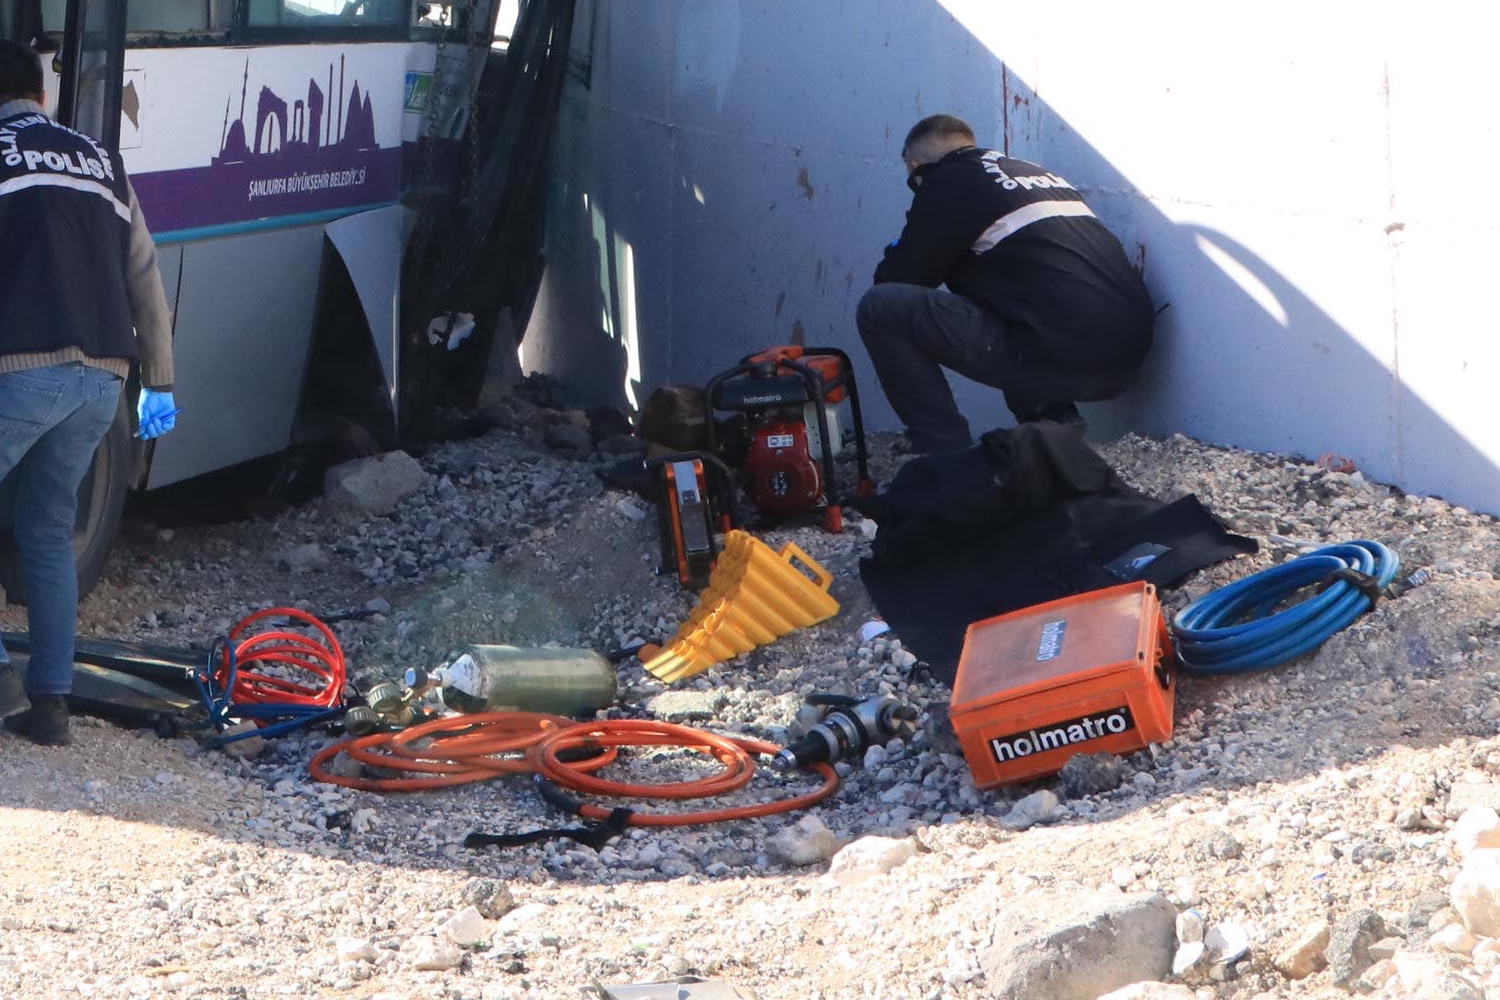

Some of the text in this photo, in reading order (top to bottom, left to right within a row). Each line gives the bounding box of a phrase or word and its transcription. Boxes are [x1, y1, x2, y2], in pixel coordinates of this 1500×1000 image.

[0, 127, 22, 167] OLAY
[249, 179, 286, 201] ŞANLIURFA
[287, 170, 329, 194] BÜYÜKŞEHİR
[743, 394, 782, 405] holmatro
[993, 713, 1127, 763] holmatro
